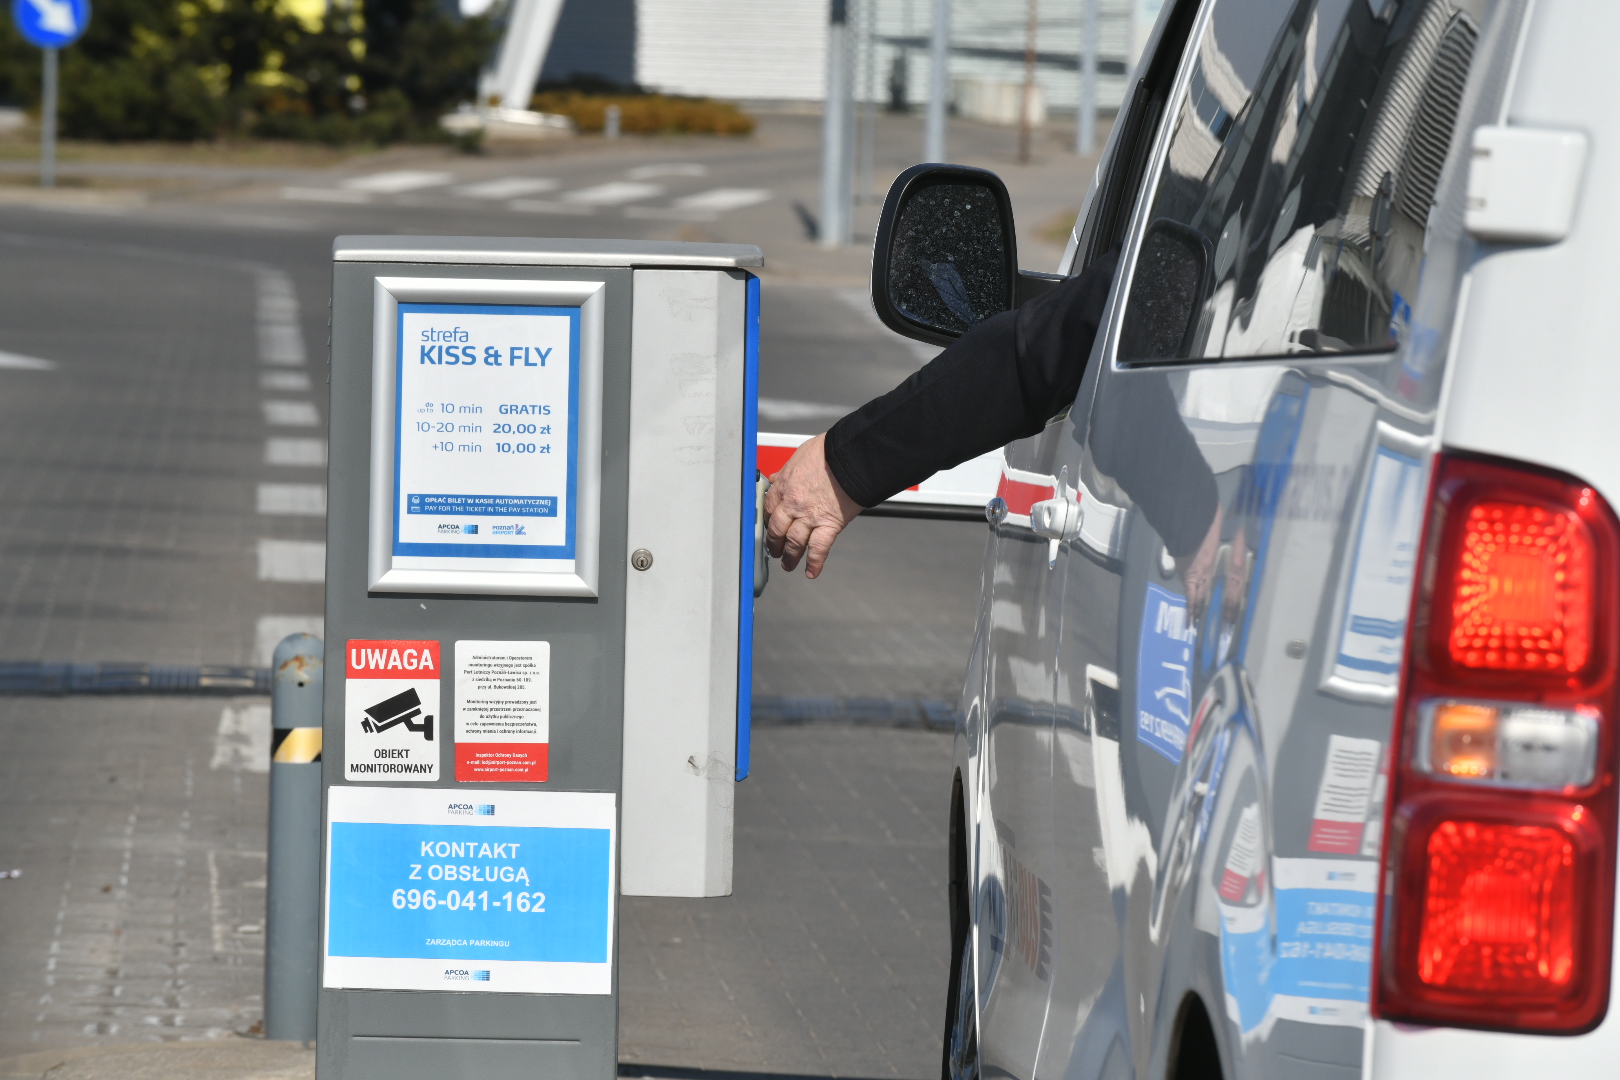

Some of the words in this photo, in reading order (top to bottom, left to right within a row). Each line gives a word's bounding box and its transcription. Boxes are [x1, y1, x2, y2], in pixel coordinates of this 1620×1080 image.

[421, 326, 468, 342] strefa
[420, 344, 476, 366] KISS
[484, 346, 502, 366] &
[510, 346, 553, 367] FLY
[440, 403, 454, 414] 10
[459, 404, 483, 414] min
[499, 404, 551, 415] GRATIS
[416, 422, 454, 433] 10-20
[458, 423, 482, 433] min
[493, 423, 537, 435] 20,00
[540, 424, 551, 434] zł
[432, 442, 454, 452] +10
[458, 442, 482, 452] min
[495, 442, 536, 454] 10,00
[539, 443, 551, 454] zł
[351, 648, 434, 670] UWAGA
[374, 749, 410, 759] OBIEKT
[350, 764, 434, 774] MONITOROWANY
[420, 841, 521, 859] KONTAKT
[408, 864, 422, 880] Z
[428, 864, 530, 886] OBSŁUGĄ
[392, 889, 546, 913] 696-041-162
[425, 938, 468, 948] ZARZĄDCA
[470, 939, 510, 948] PARKINGU
